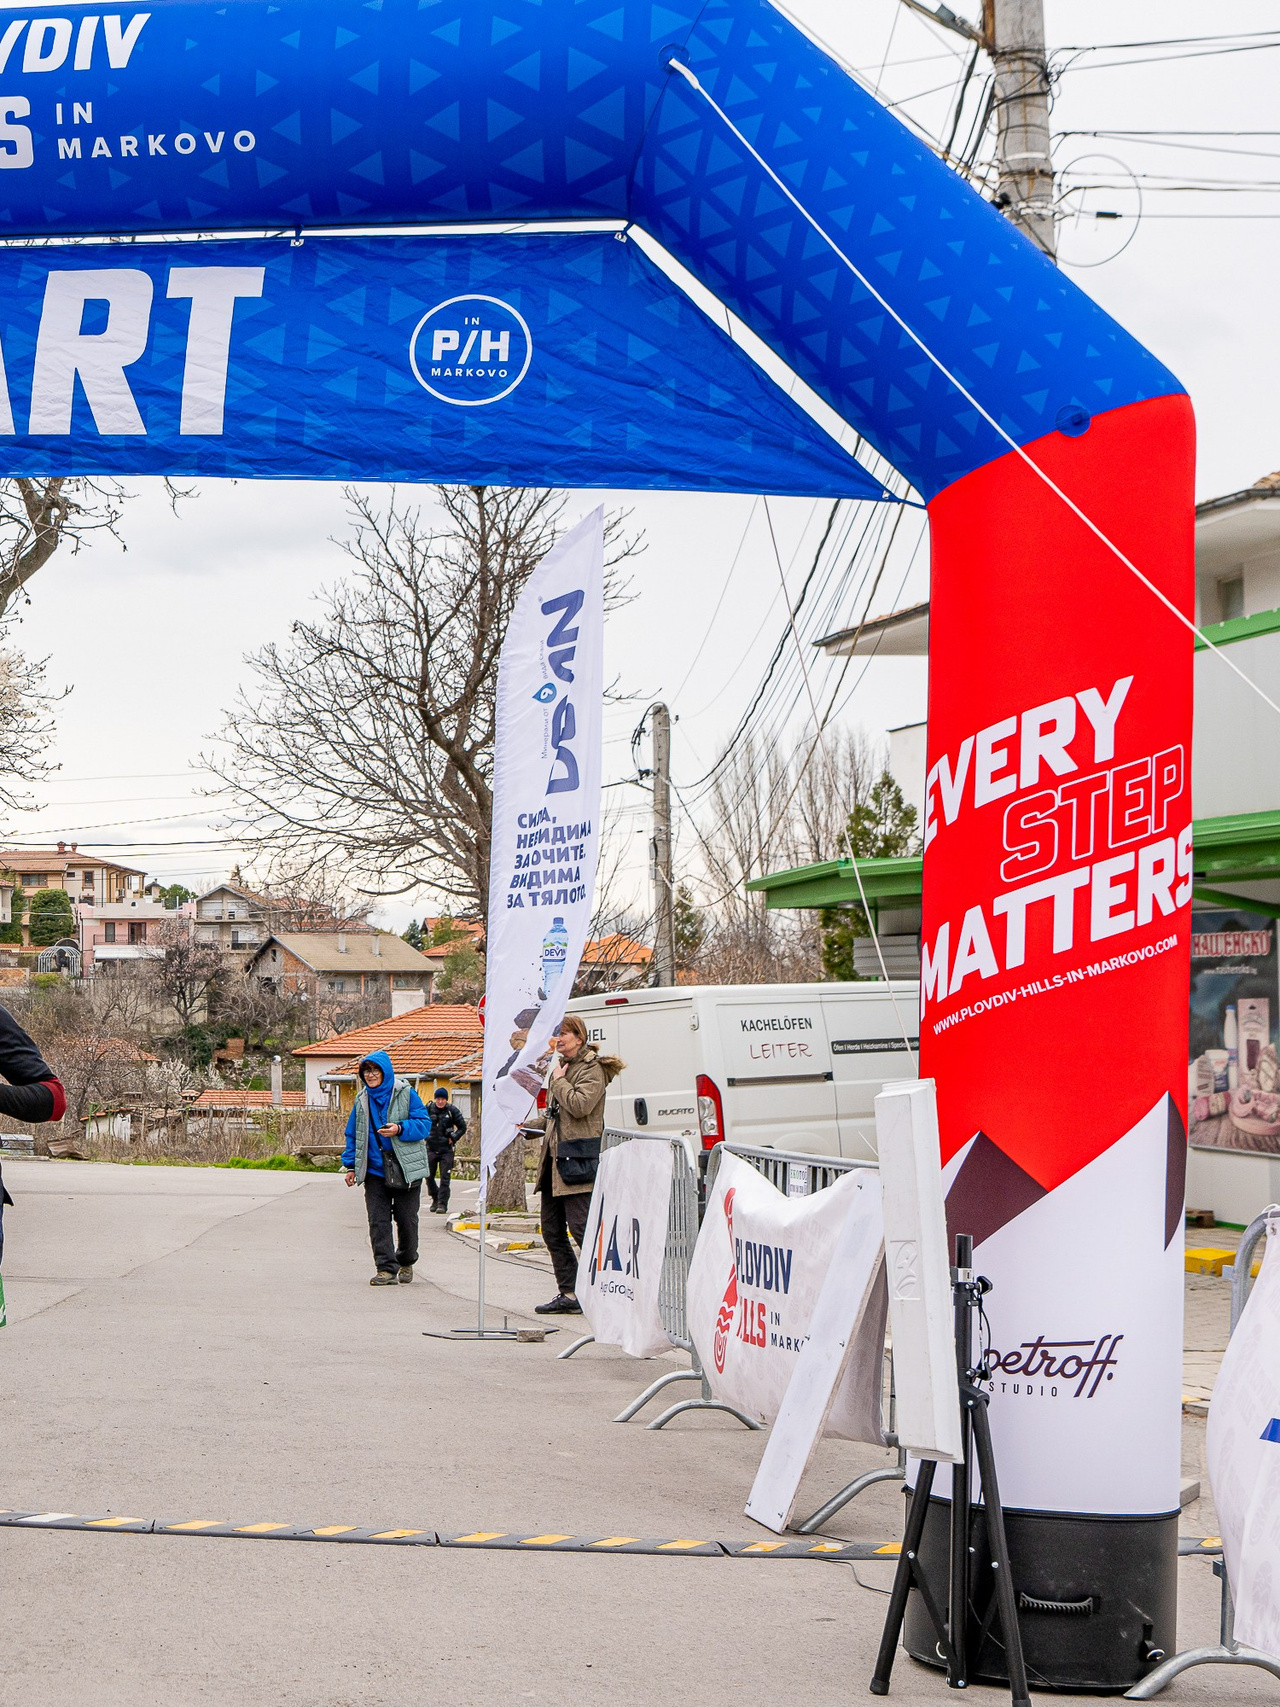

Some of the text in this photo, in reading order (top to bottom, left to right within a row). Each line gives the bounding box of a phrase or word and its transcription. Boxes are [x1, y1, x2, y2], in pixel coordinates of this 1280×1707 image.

[56, 102, 93, 125] IN
[57, 130, 257, 160] MARKOVO
[464, 317, 480, 326] IN
[432, 330, 510, 365] P/H
[431, 367, 508, 378] MARKOVO
[923, 675, 1134, 855] EVERY
[1000, 743, 1184, 883] STEP
[509, 865, 581, 890] ВИДИМА
[507, 893, 525, 909] ЗА
[920, 822, 1193, 1023] MATTERS
[933, 934, 1178, 1036] WWW.PLOVDIV-HILLS-IN-MARKOVO.COM
[741, 1015, 813, 1032] KACHELÖFEN
[749, 1042, 813, 1060] LEITER
[657, 1107, 695, 1117] DUCATO
[735, 1237, 793, 1295] PLOVDIV
[736, 1296, 781, 1349] ILLS IN
[770, 1333, 804, 1353] MARK
[988, 1381, 1058, 1398] STUDIO
